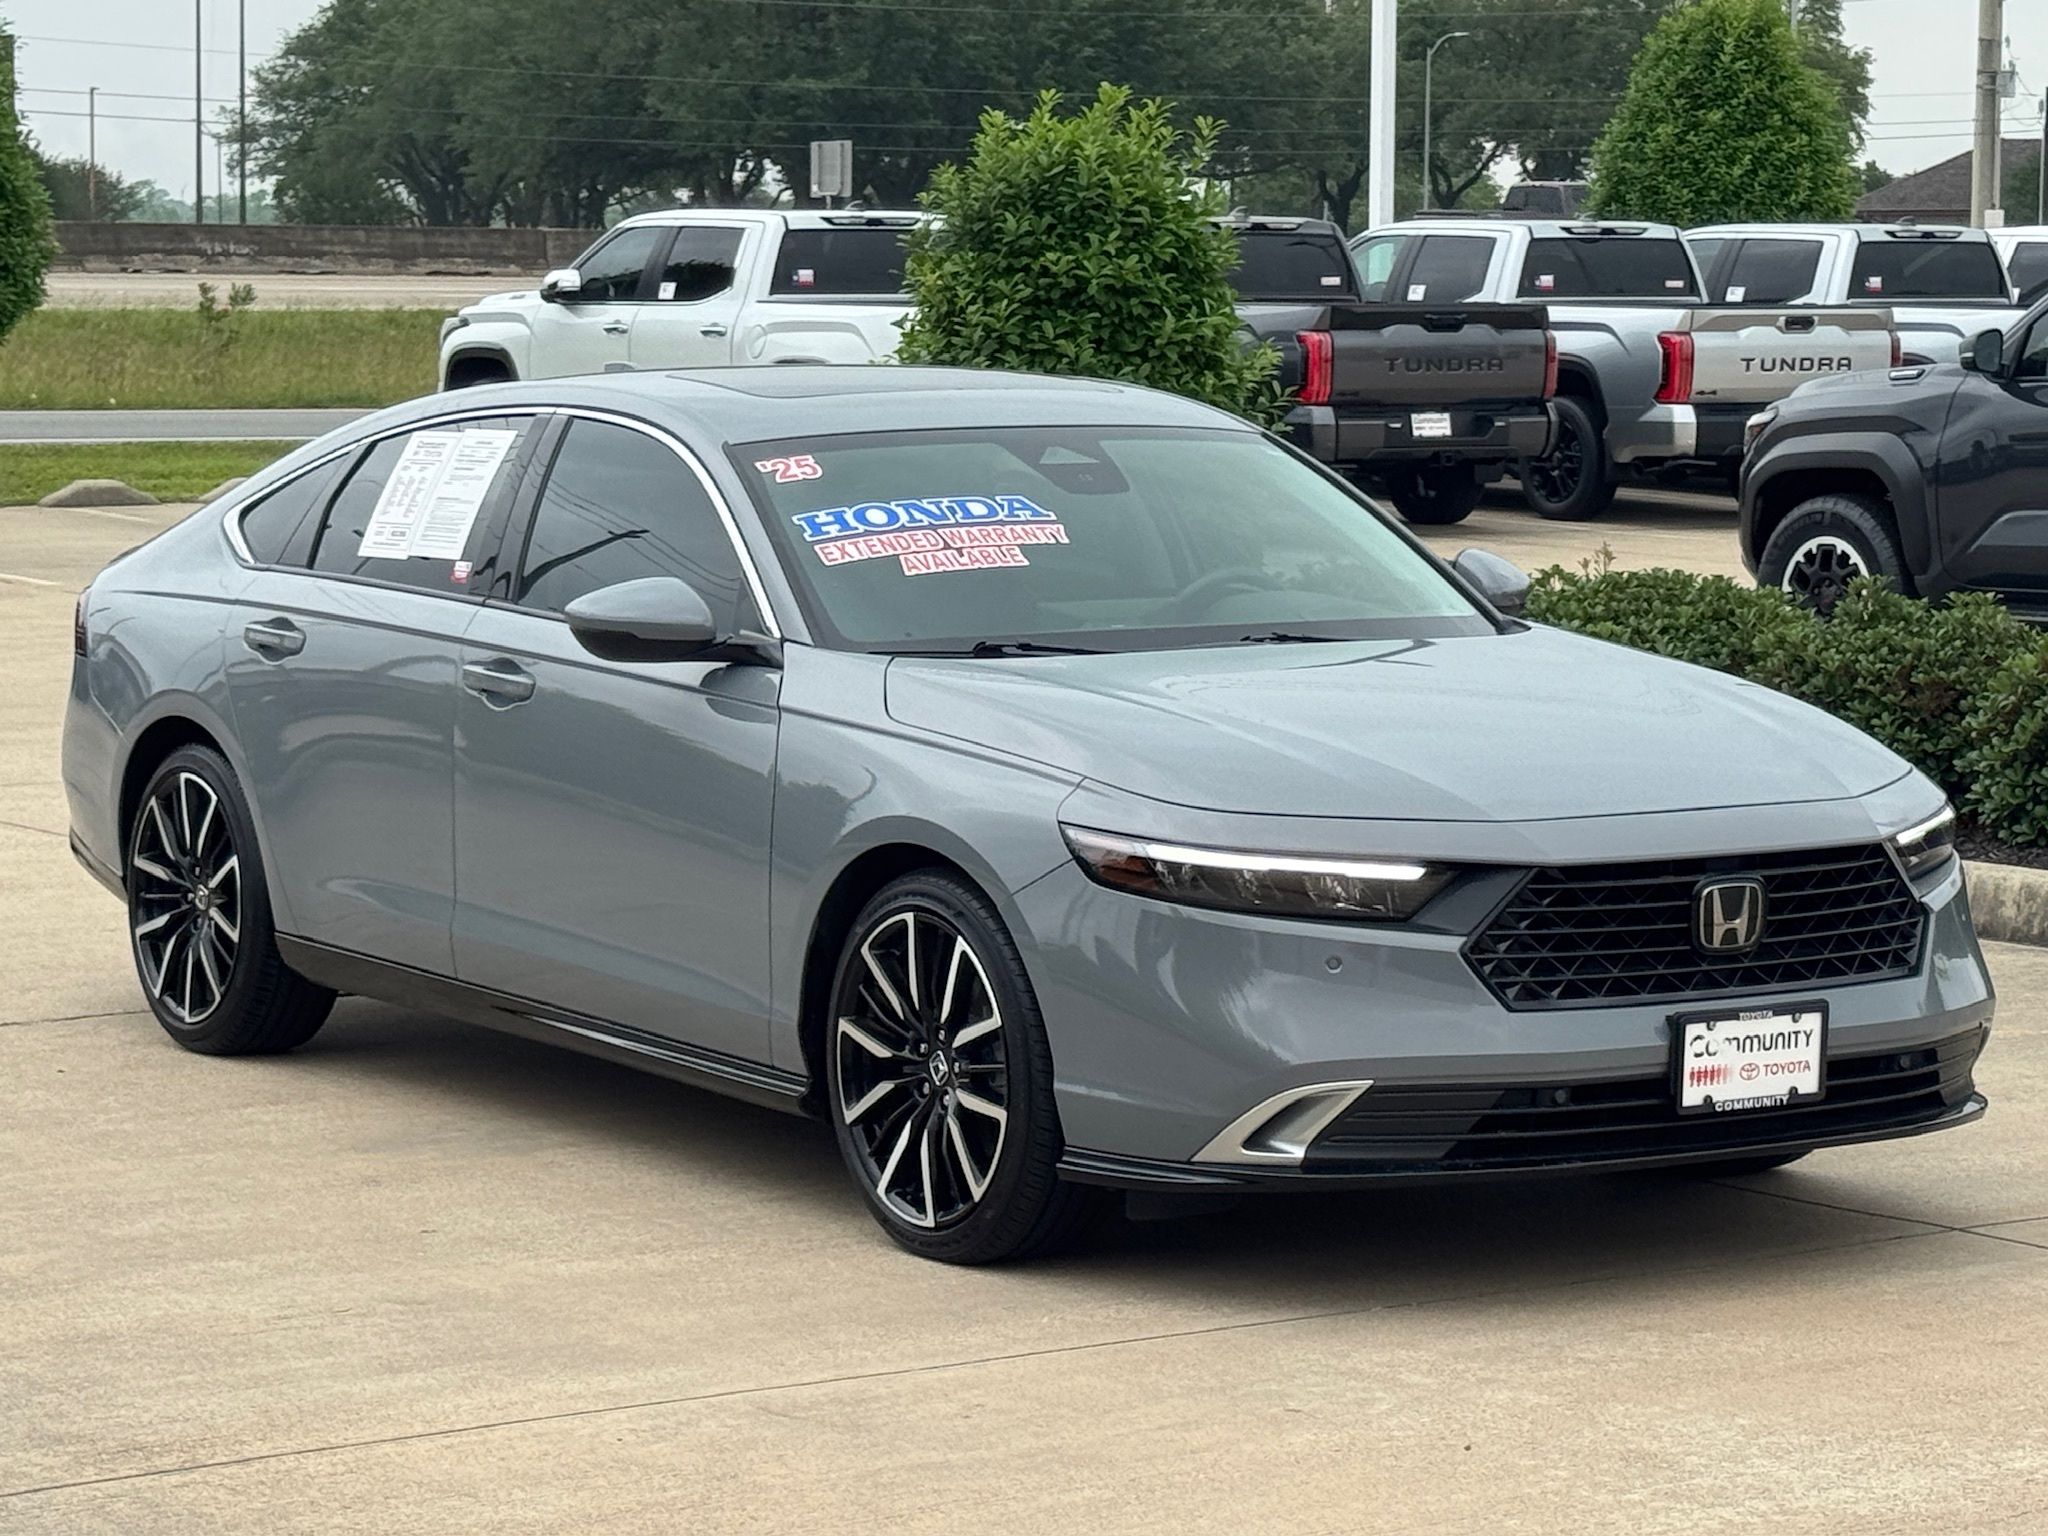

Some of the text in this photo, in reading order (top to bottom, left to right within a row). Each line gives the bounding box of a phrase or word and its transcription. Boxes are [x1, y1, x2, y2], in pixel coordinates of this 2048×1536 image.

[1384, 356, 1504, 374] TUNDRA
[1740, 356, 1852, 373] TUNDRA
[794, 494, 1055, 540] HONDA
[819, 524, 1067, 563] EXTENDED WARRANTY
[903, 547, 1027, 572] AVAILABLE
[1738, 1009, 1774, 1022] TOYOTA
[1762, 1060, 1811, 1077] TOYOTA
[1714, 1094, 1790, 1112] COMMUNITY
